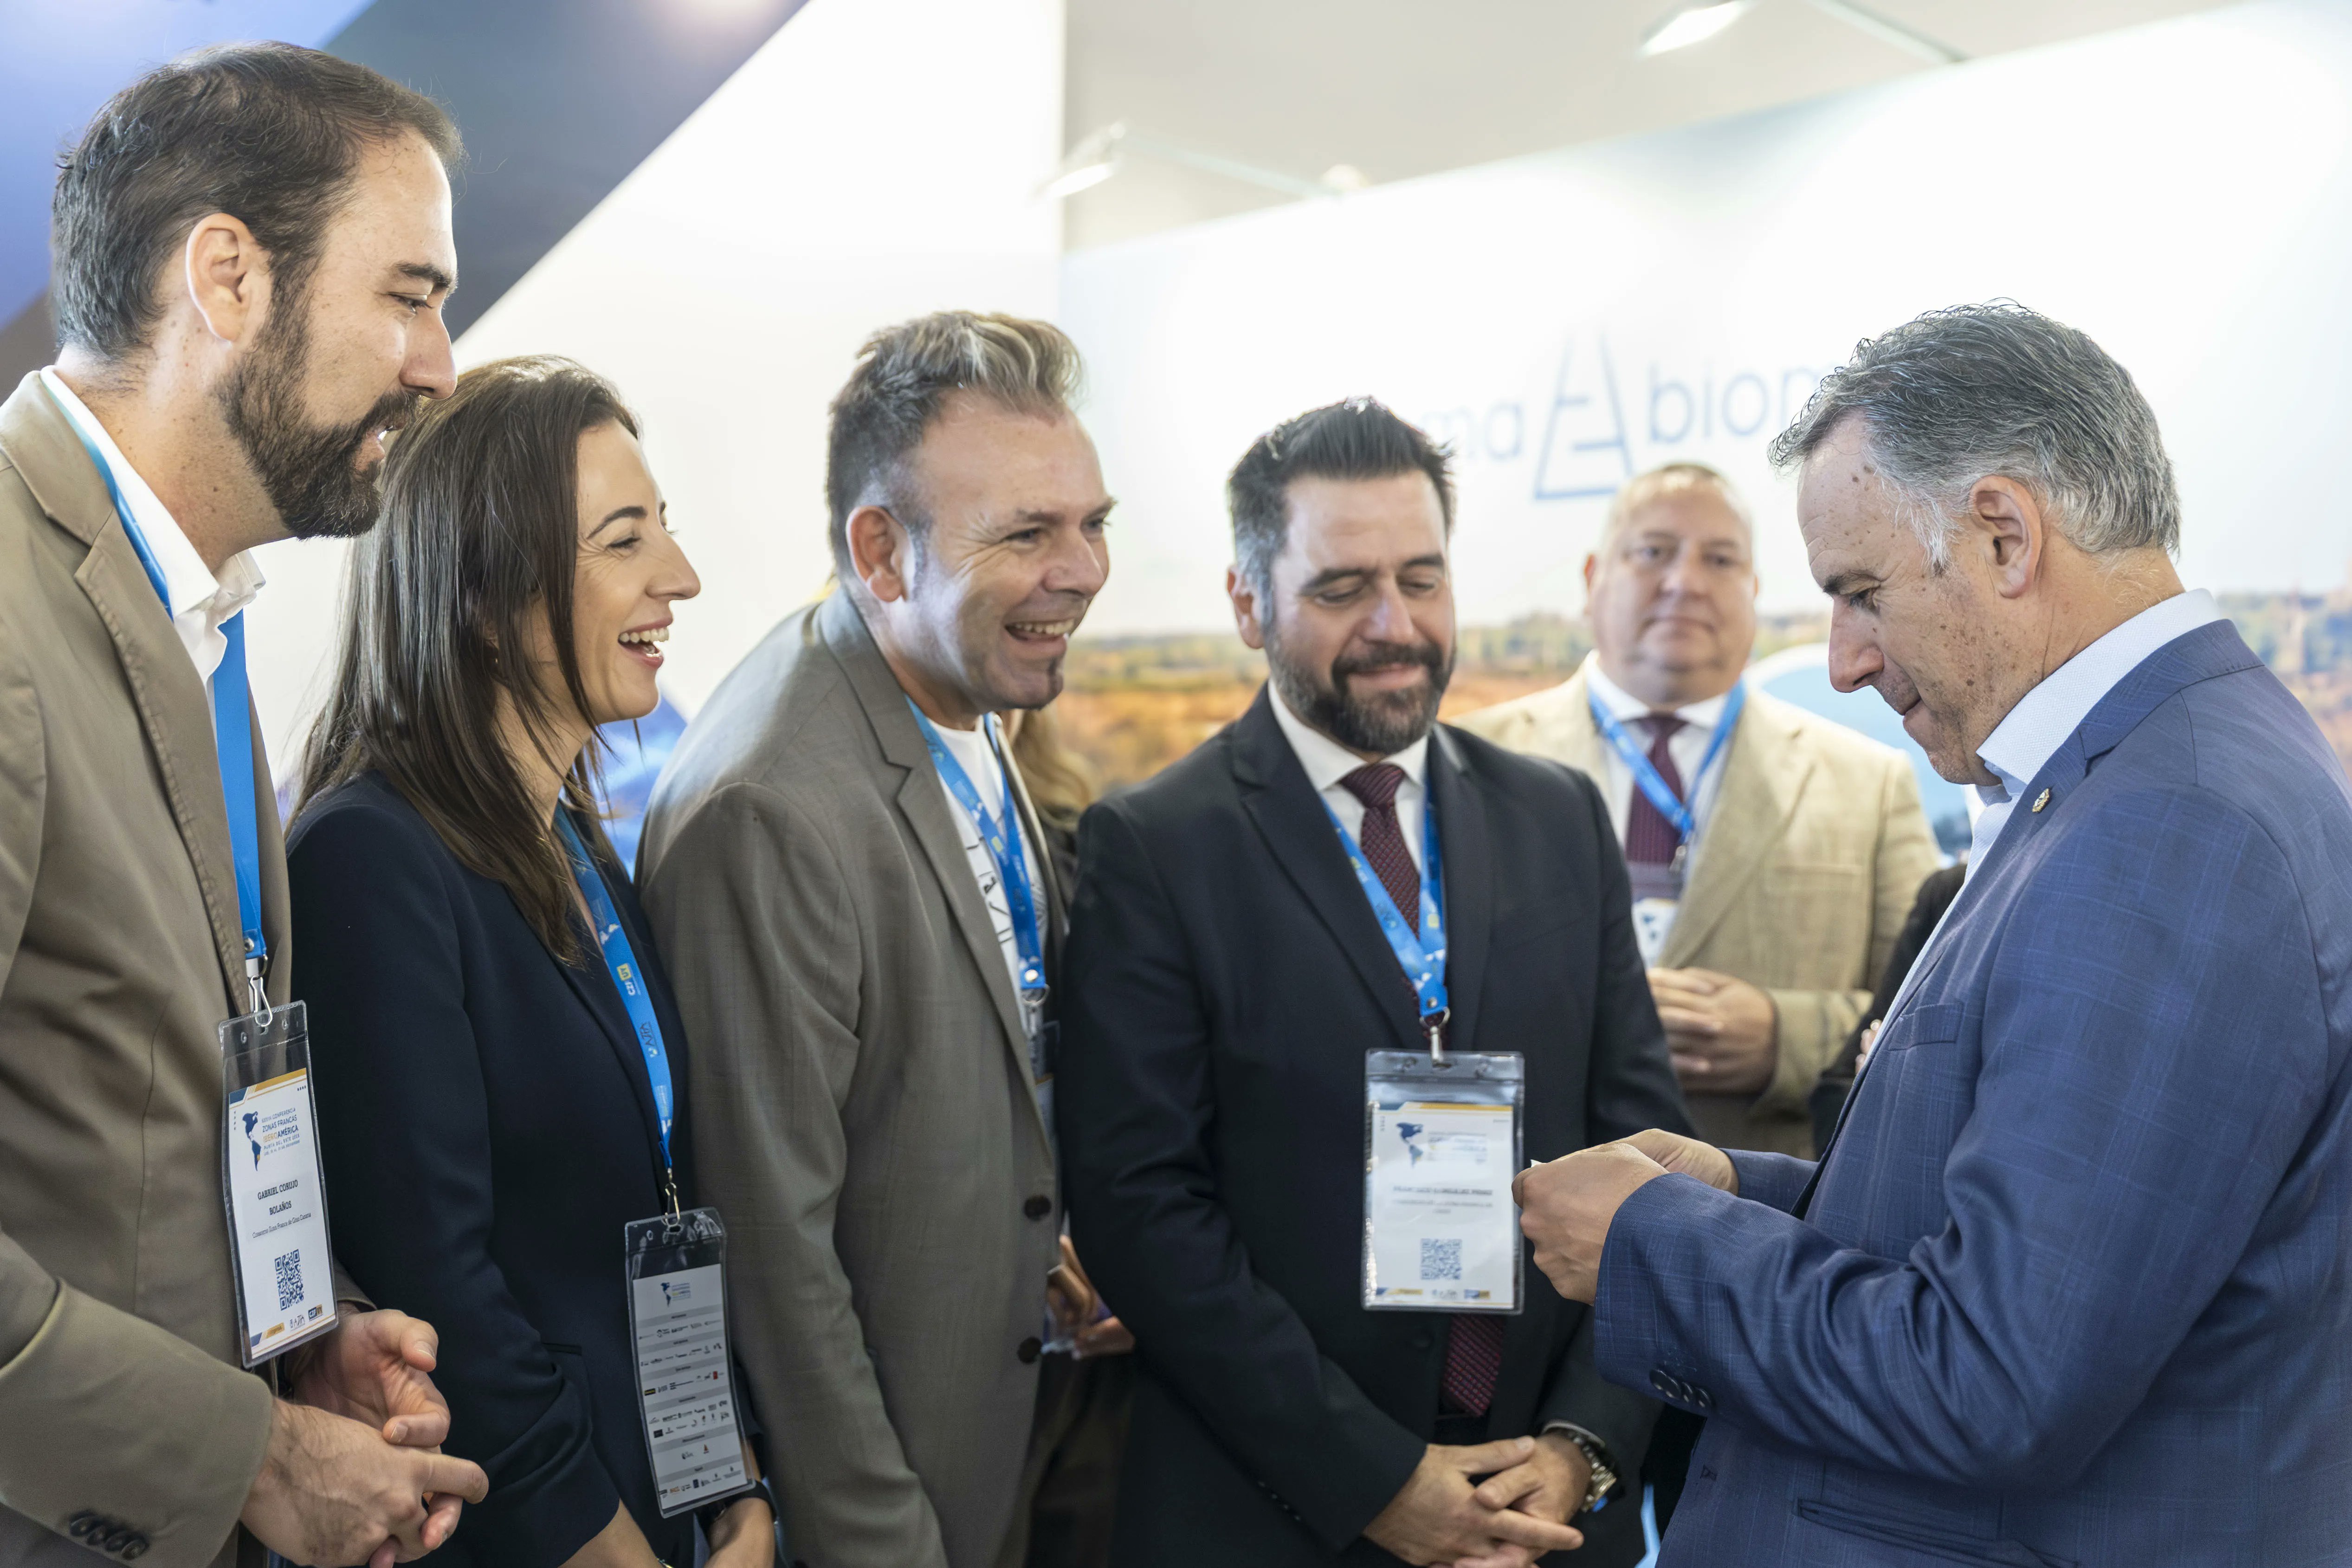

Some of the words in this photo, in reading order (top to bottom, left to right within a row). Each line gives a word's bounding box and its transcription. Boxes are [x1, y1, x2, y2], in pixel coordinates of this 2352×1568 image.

[272, 1108, 295, 1119] CONFERENCIA
[262, 1122, 277, 1133] ZONAS
[278, 1114, 297, 1127] FRANCAS
[257, 1186, 279, 1200] GABRIEL
[279, 1179, 298, 1193] CORUJO
[269, 1200, 292, 1215] BOLAÑOS
